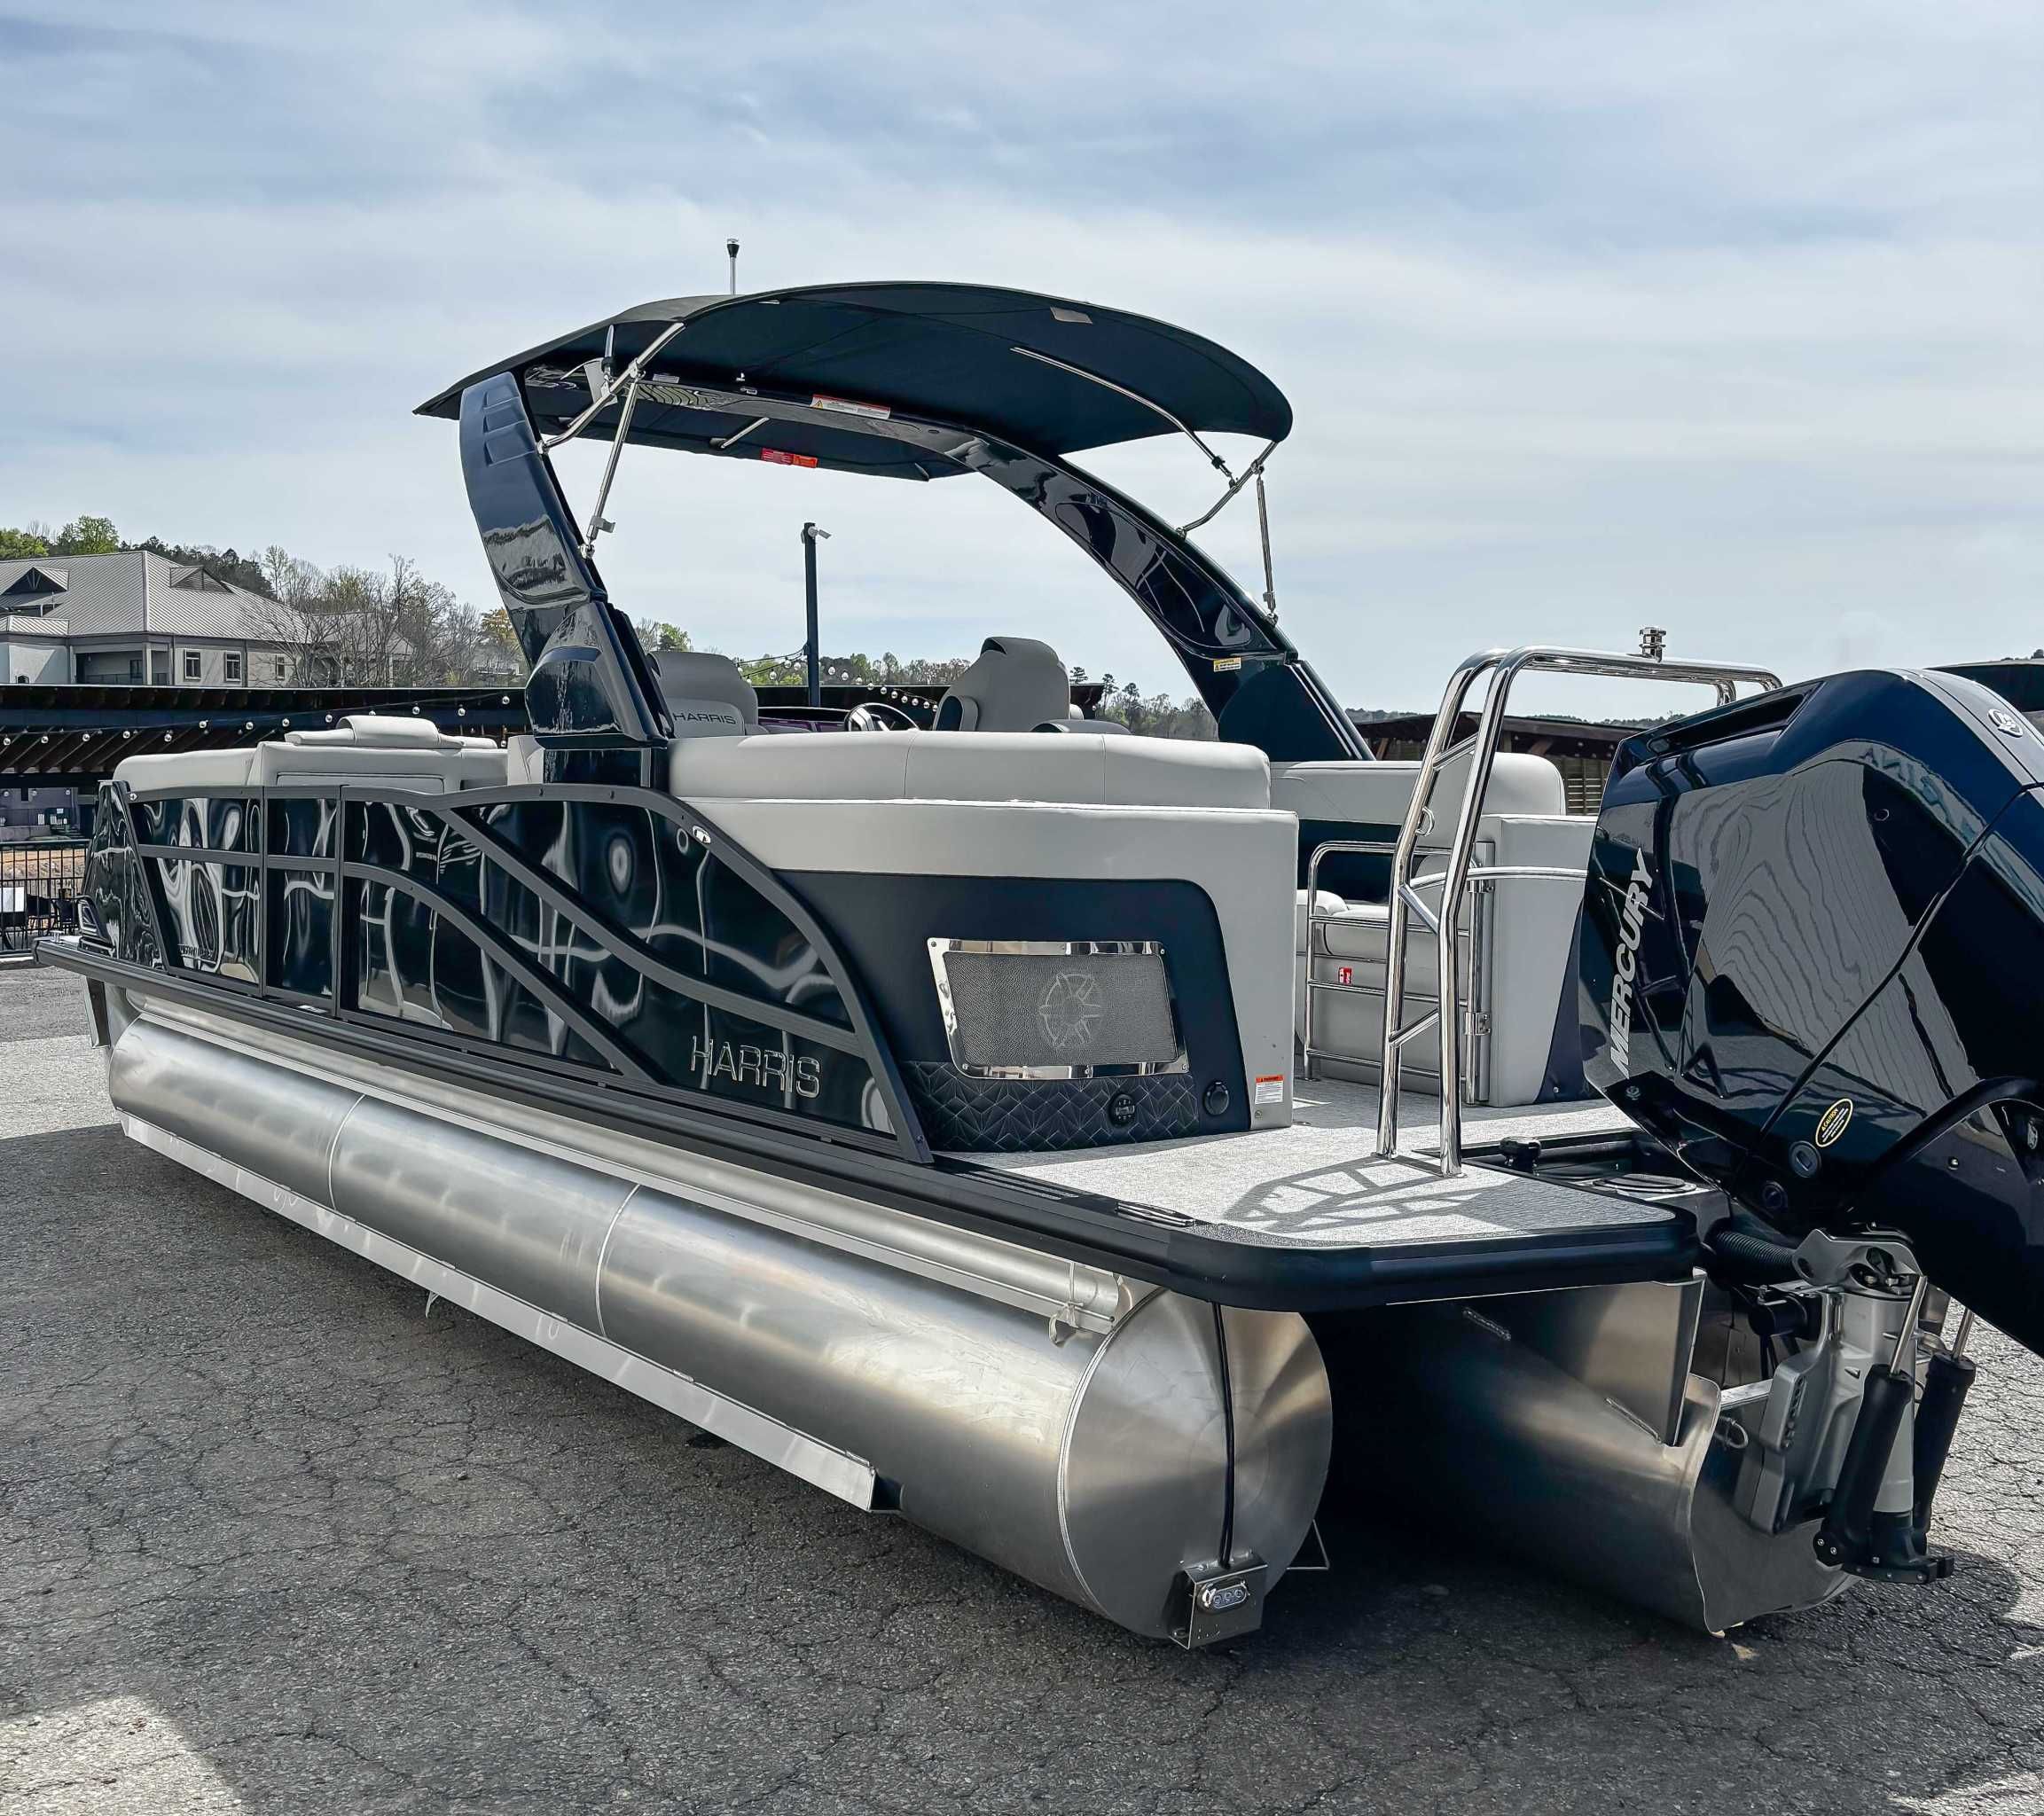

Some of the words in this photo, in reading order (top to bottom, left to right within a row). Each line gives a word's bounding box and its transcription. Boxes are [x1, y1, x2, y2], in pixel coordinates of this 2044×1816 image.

[674, 712, 736, 724] HARRIS
[1610, 847, 1653, 1080] MERCURY
[690, 1035, 820, 1099] HARRIS
